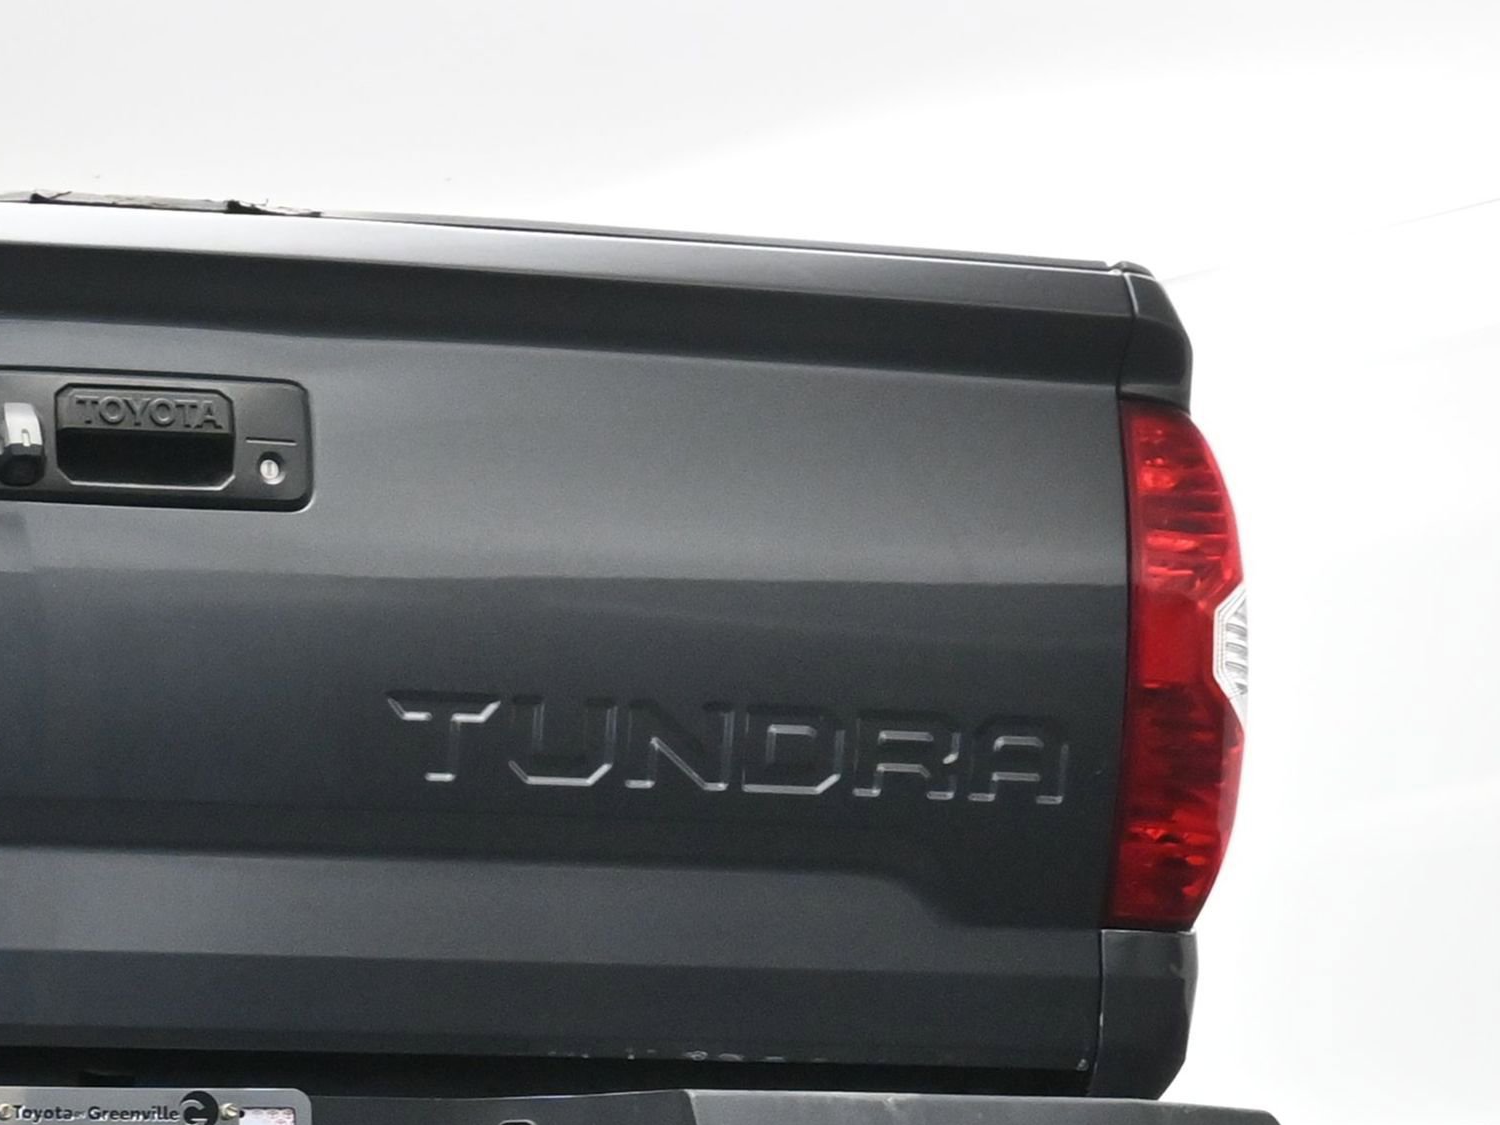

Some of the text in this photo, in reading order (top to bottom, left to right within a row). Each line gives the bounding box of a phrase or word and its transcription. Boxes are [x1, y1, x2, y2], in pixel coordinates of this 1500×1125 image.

[74, 395, 223, 430] TOYOTA
[387, 690, 1072, 804] TUNDRA
[12, 1104, 73, 1123] Toyota
[88, 1105, 180, 1122] Greenville
